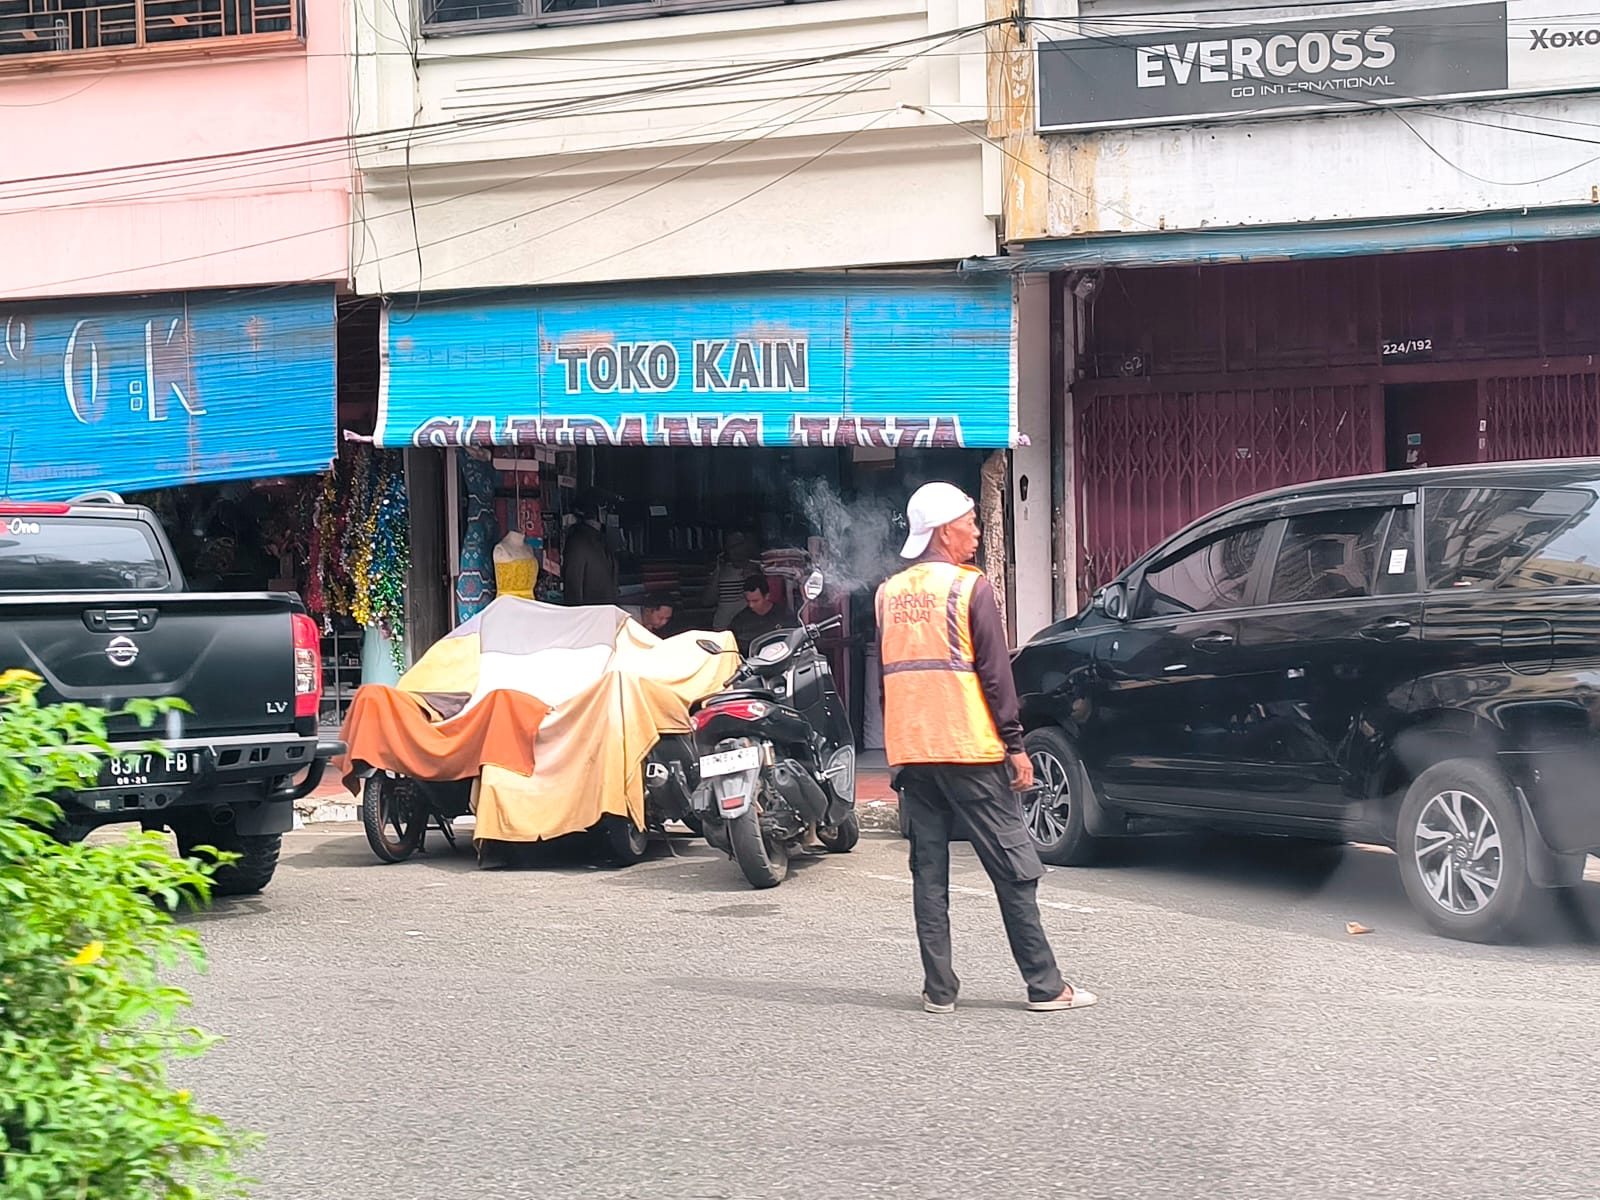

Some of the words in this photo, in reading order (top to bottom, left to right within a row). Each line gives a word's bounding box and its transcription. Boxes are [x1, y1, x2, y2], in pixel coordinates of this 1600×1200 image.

[1136, 25, 1396, 88] EVERCOSS
[1231, 85, 1255, 98] GO
[1260, 75, 1396, 96] INTERNATIONAL
[1383, 339, 1432, 355] 224/192
[555, 340, 680, 394] TOKO
[692, 338, 809, 392] KAIN
[889, 592, 936, 612] PARKIR
[266, 701, 288, 713] LV
